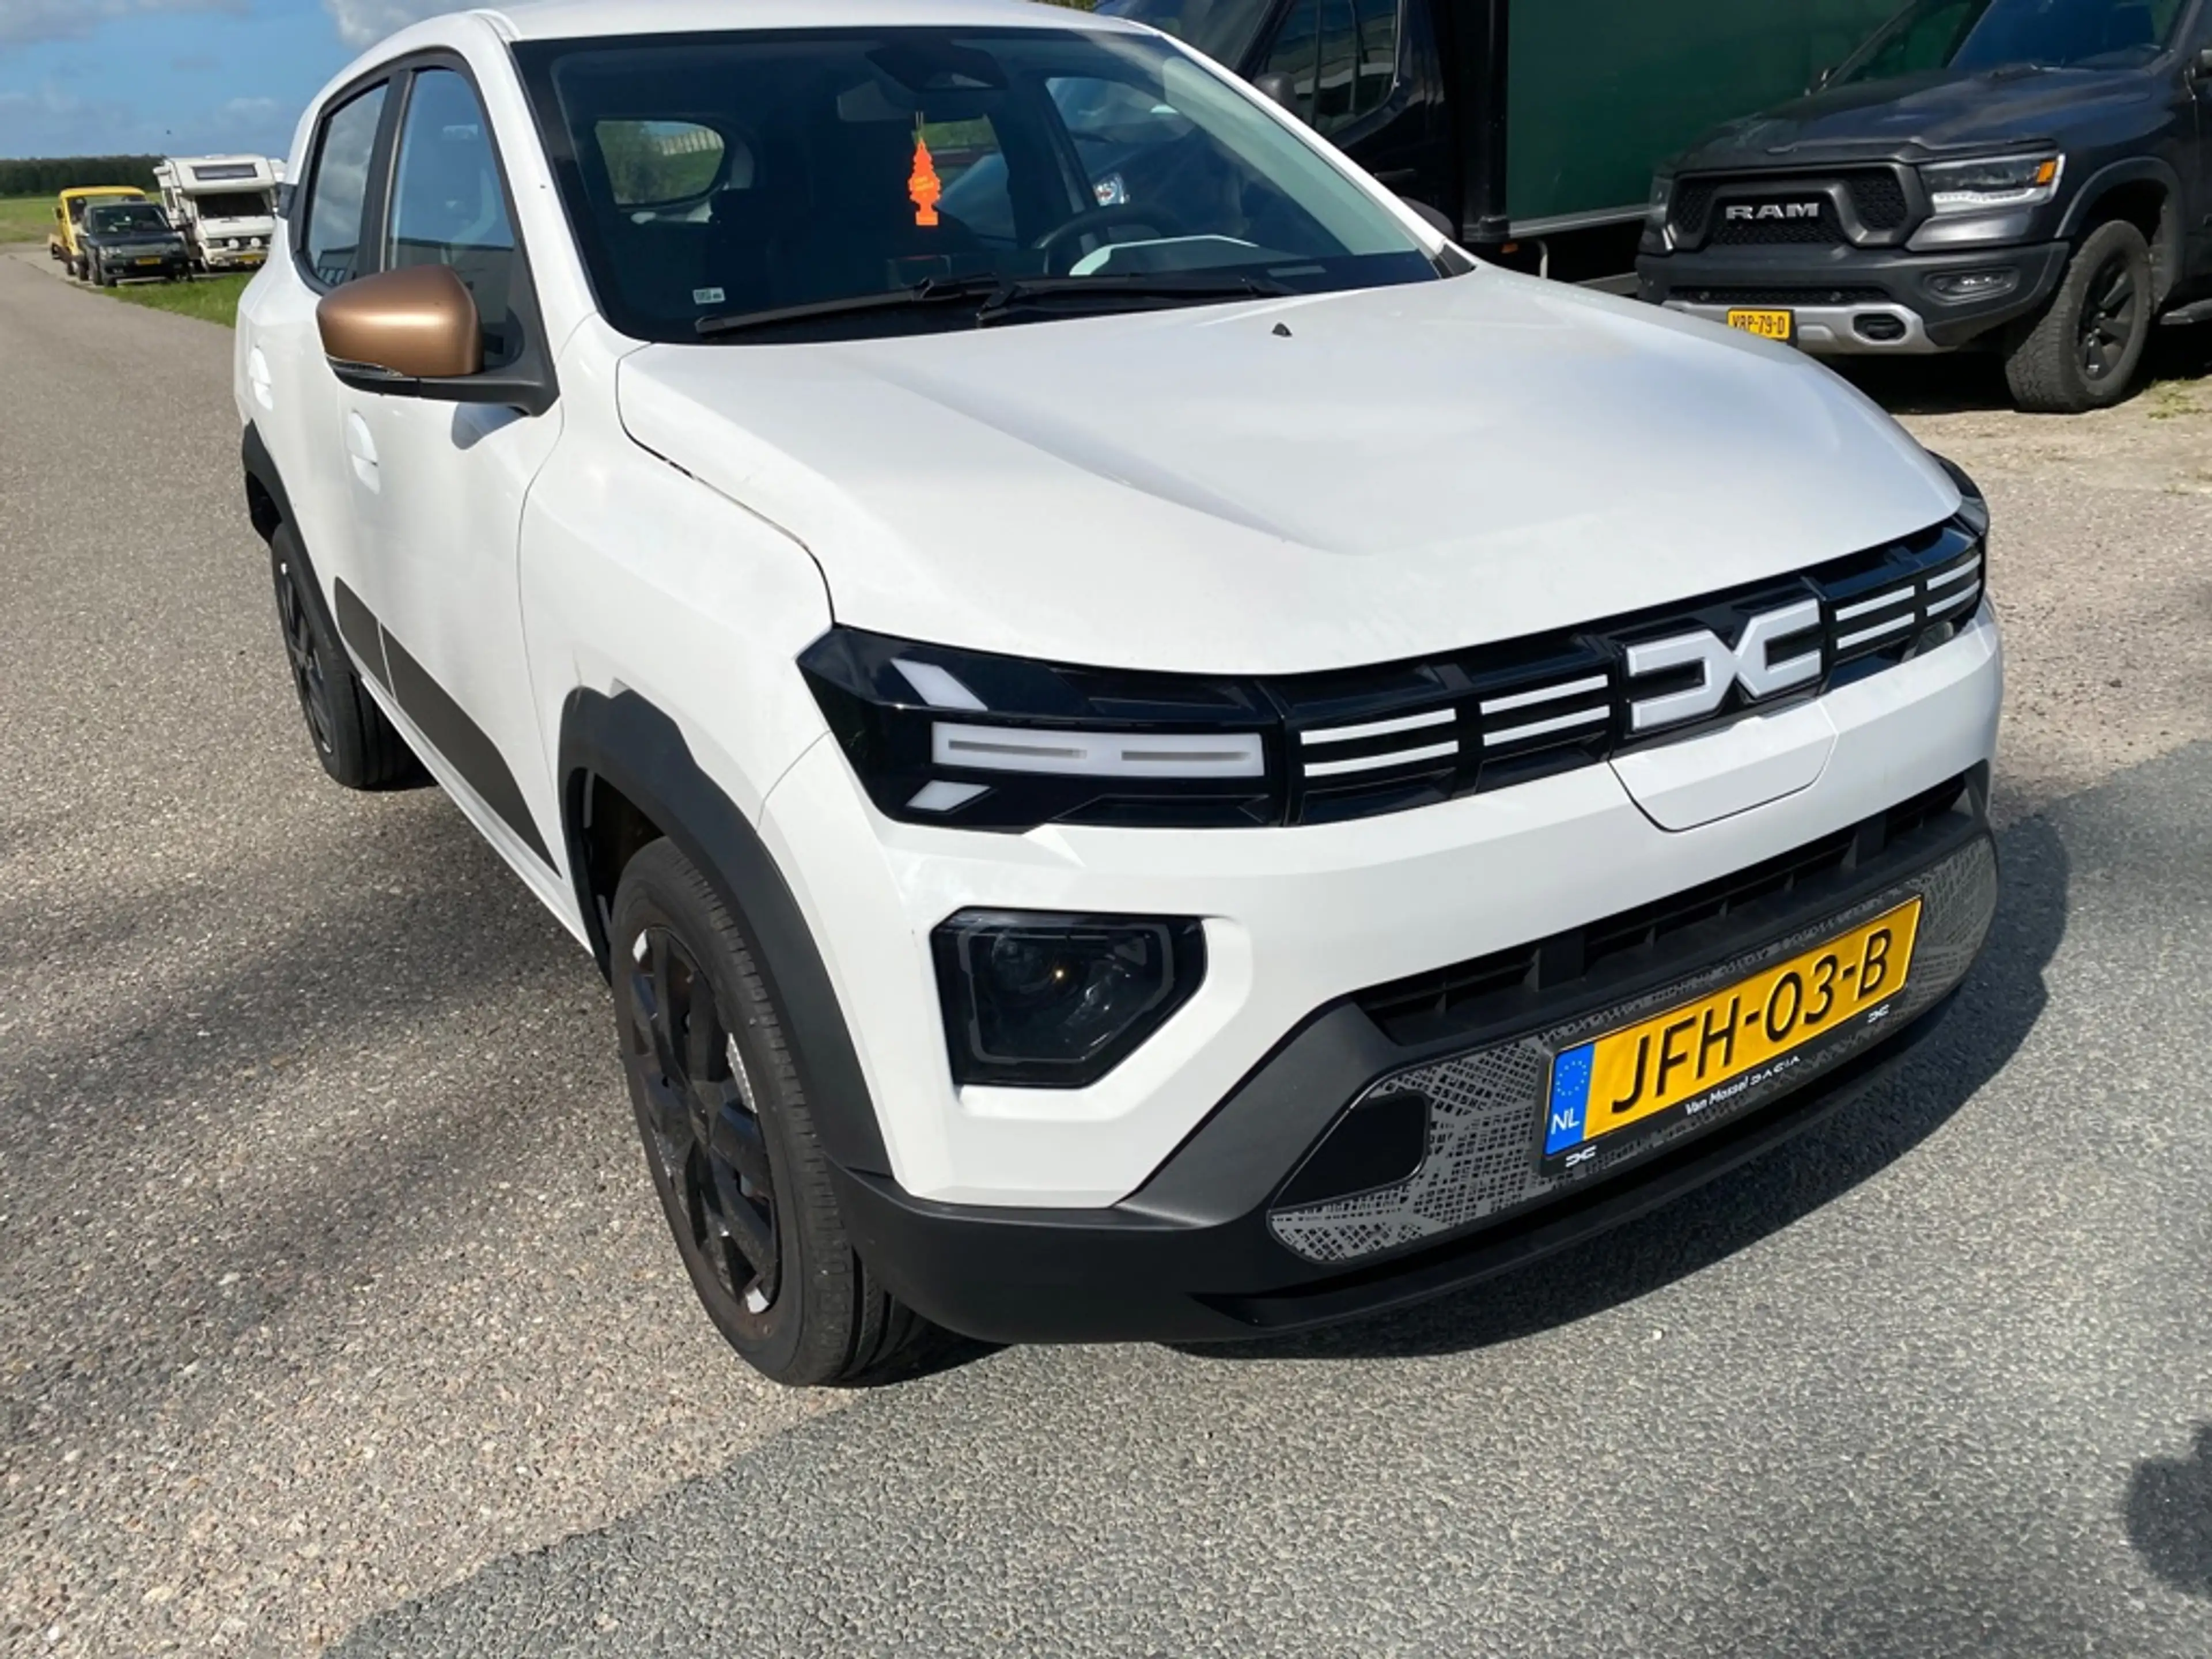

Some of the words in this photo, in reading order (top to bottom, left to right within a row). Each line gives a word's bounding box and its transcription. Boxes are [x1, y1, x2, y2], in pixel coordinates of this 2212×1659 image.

[1726, 203, 1819, 219] RAM
[1612, 928, 1892, 1113] JFH-03-B
[1551, 1107, 1580, 1135] NL
